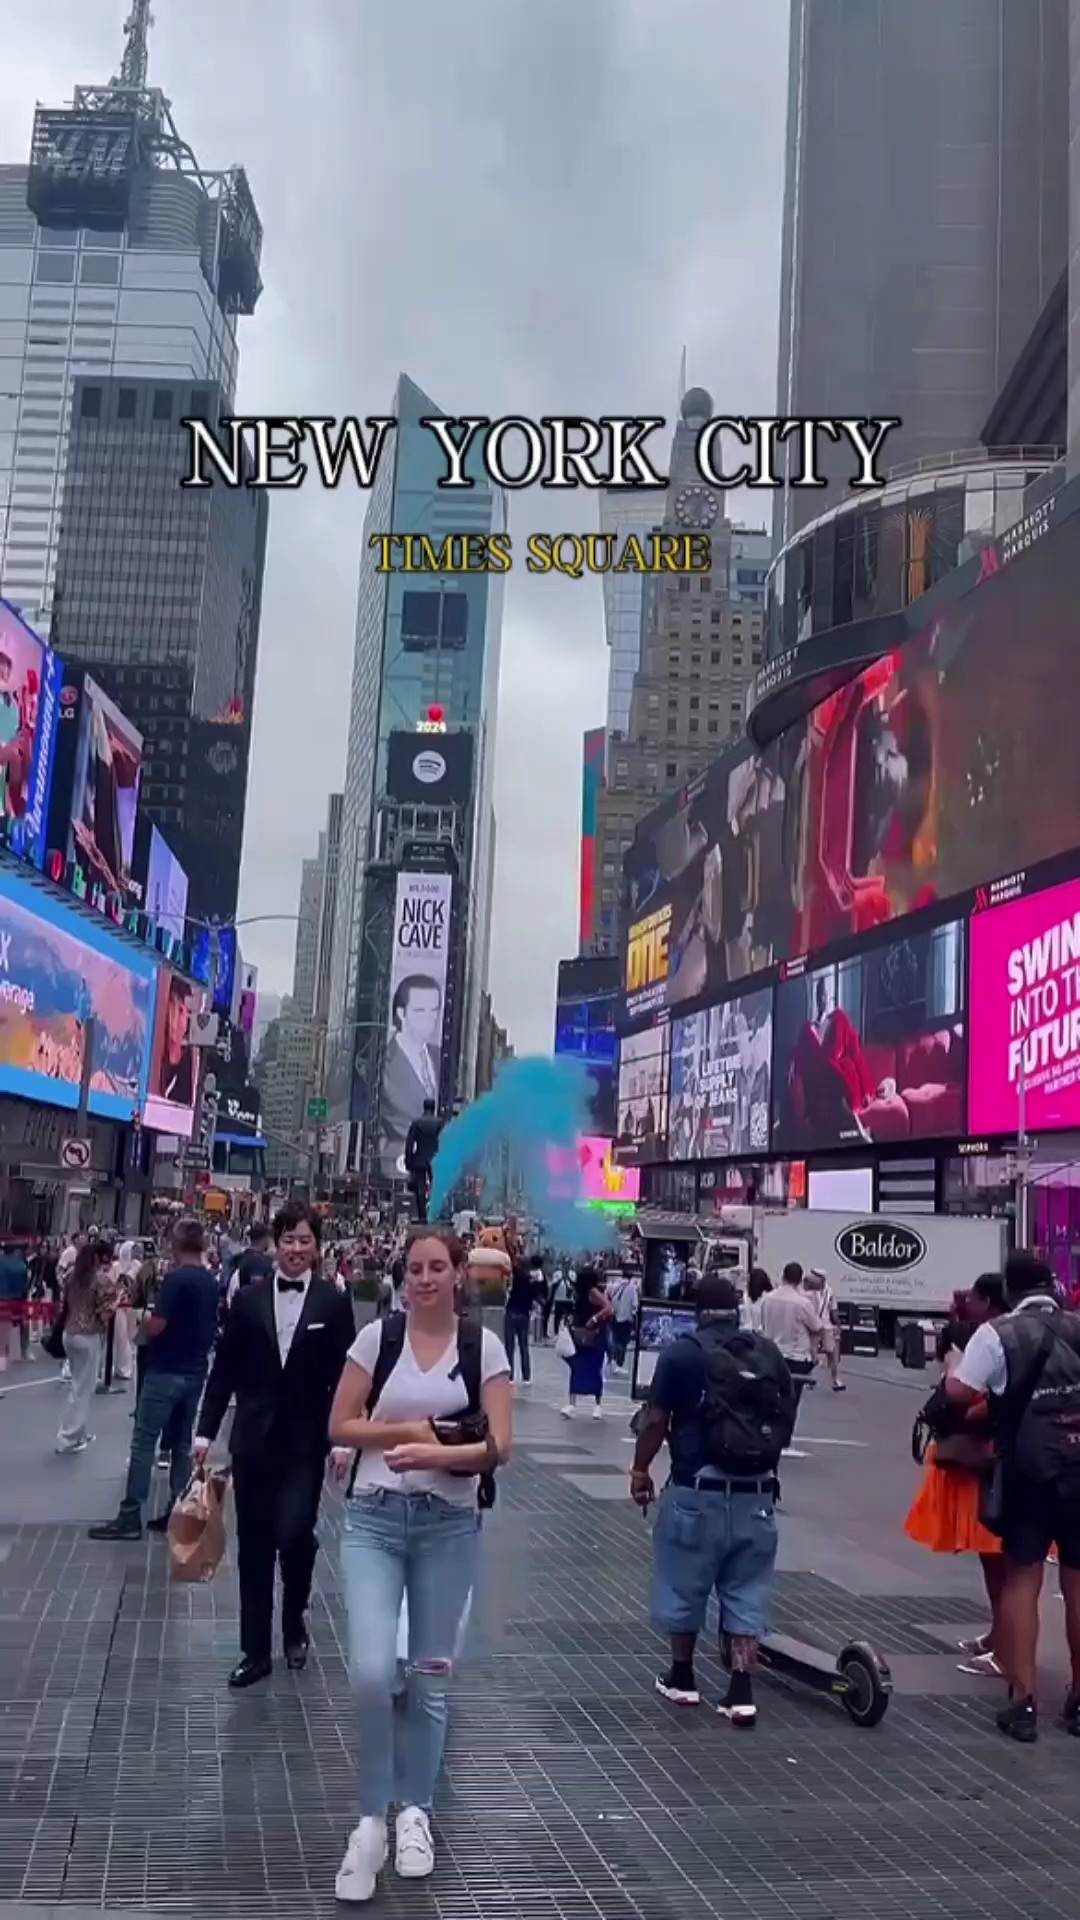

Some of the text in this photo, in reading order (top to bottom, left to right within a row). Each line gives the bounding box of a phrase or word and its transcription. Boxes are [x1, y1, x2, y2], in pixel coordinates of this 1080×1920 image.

[1002, 495, 1056, 547] MARRIOTT
[1002, 519, 1049, 565] MARQUIS
[59, 708, 75, 719] LG
[416, 721, 447, 733] 2024
[402, 897, 445, 925] NICK
[398, 922, 443, 950] CAVE
[1010, 979, 1059, 1037] INTO
[849, 1232, 917, 1259] Baldor
